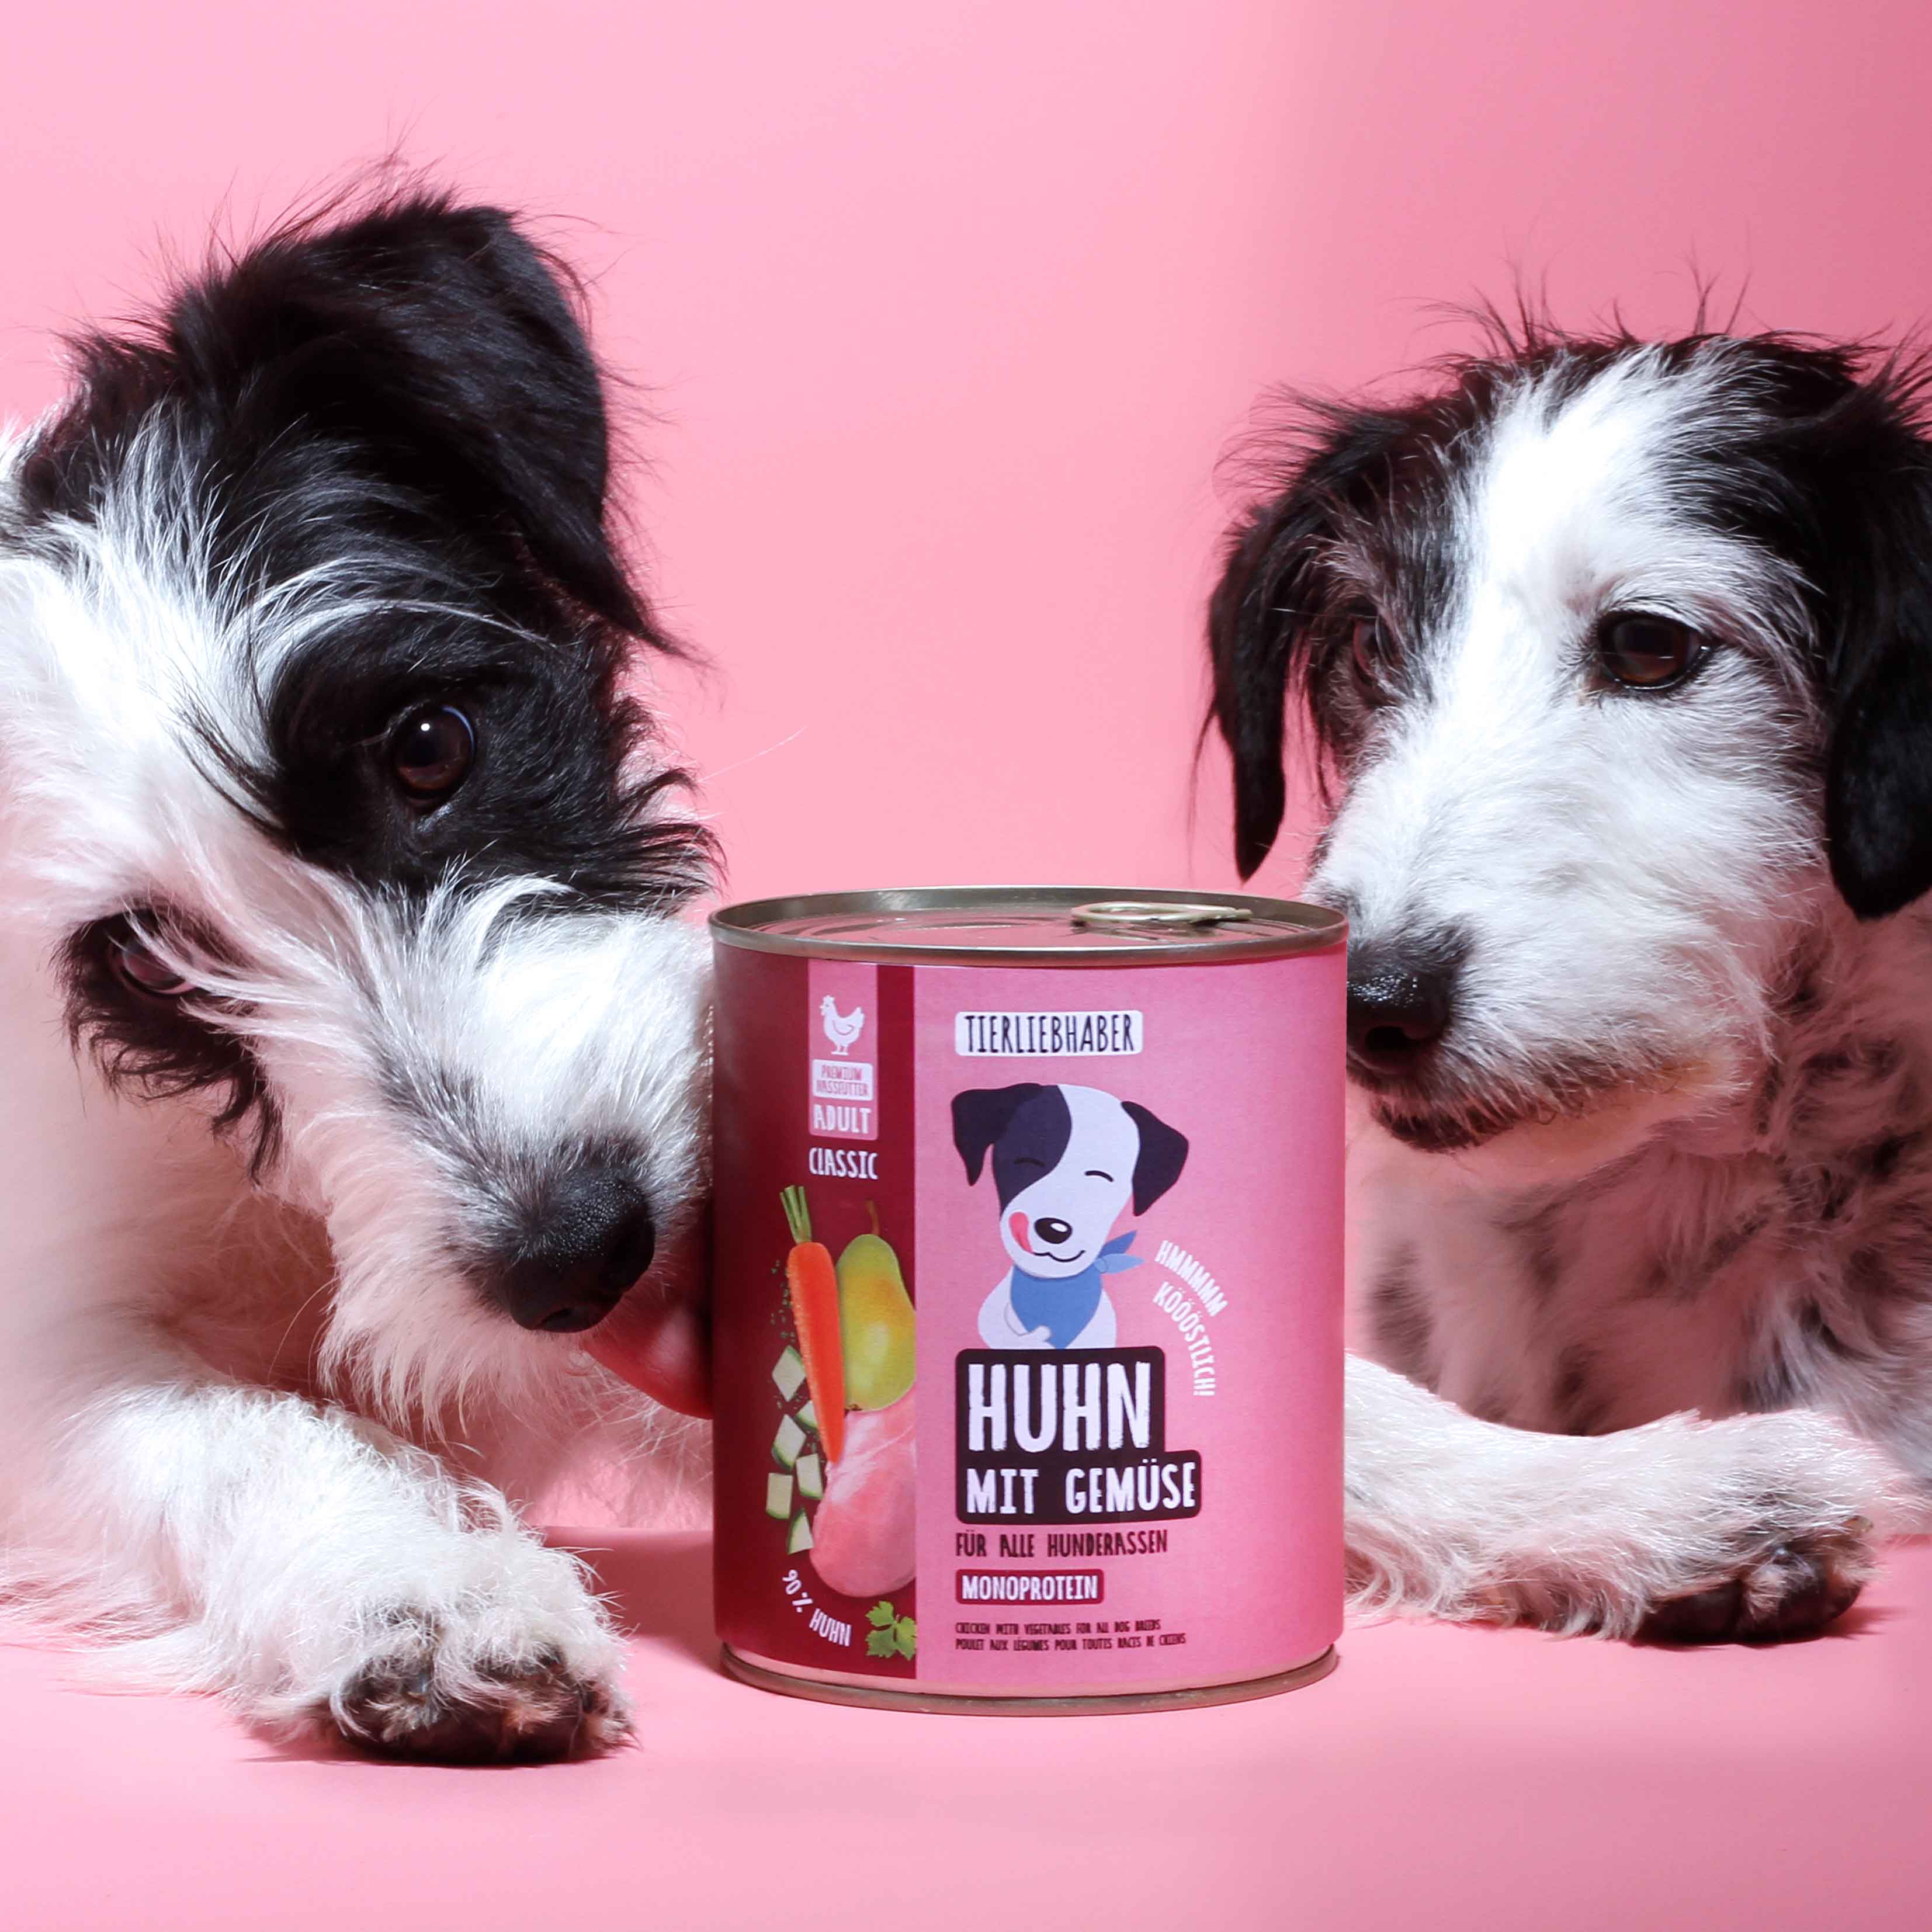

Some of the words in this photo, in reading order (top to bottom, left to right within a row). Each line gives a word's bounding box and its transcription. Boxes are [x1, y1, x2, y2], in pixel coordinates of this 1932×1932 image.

[965, 1014, 1134, 1053] TIERLIEBHABER
[813, 1104, 872, 1134] ADULT
[809, 1147, 879, 1180] CLASSIC
[1152, 1281, 1216, 1396] KÖÖÖSTLICH!
[967, 1361, 1151, 1453] HUHN
[966, 1468, 1039, 1514] MIT
[1065, 1458, 1196, 1514] GEMÜSE
[955, 1529, 987, 1558] FÜR
[999, 1534, 1035, 1558] ALLE
[1047, 1529, 1168, 1558] HUNDERASSEN
[962, 1574, 1099, 1601] MONOPROTEIN
[782, 1569, 813, 1613] 90%
[809, 1608, 852, 1647] HUHN
[1076, 1622, 1091, 1634] FOR
[1096, 1622, 1109, 1633] ALL
